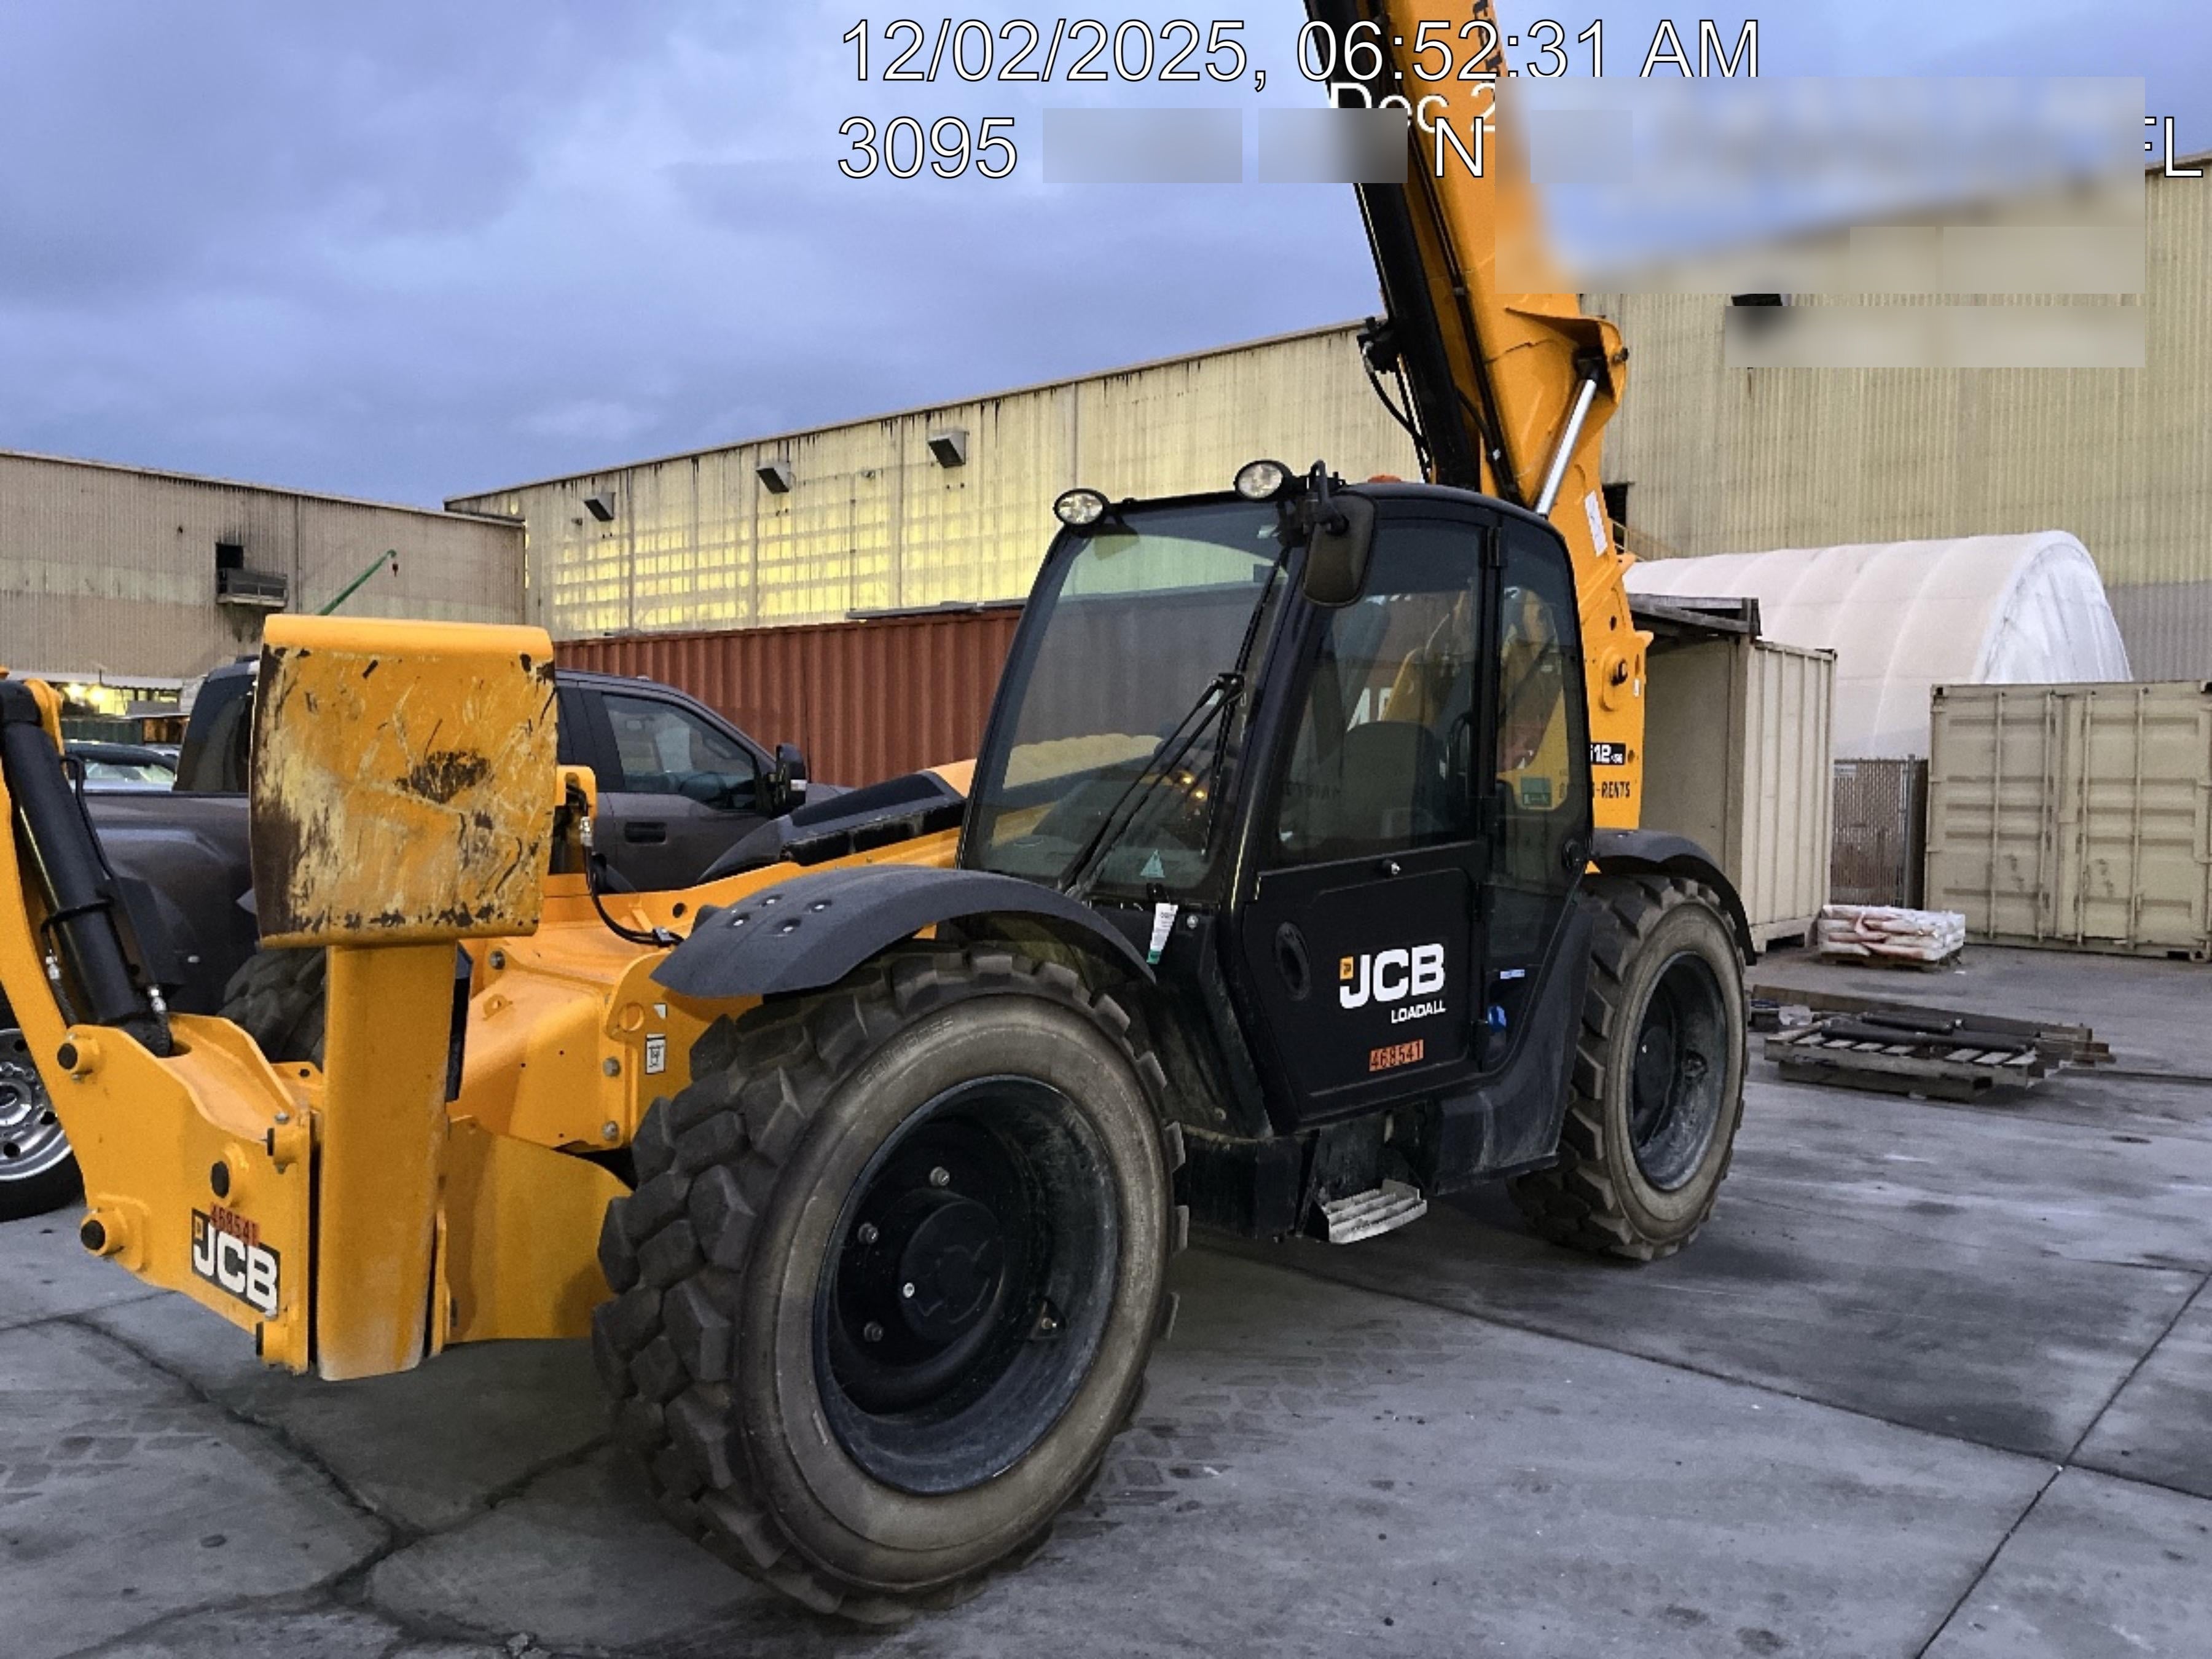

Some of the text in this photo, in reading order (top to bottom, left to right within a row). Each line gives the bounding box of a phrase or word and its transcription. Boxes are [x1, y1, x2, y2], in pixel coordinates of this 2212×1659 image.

[1339, 943, 1445, 1009] JCB
[1391, 999, 1446, 1024] LOADALL
[1370, 1040, 1424, 1070] 468541
[193, 1220, 278, 1316] JCB
